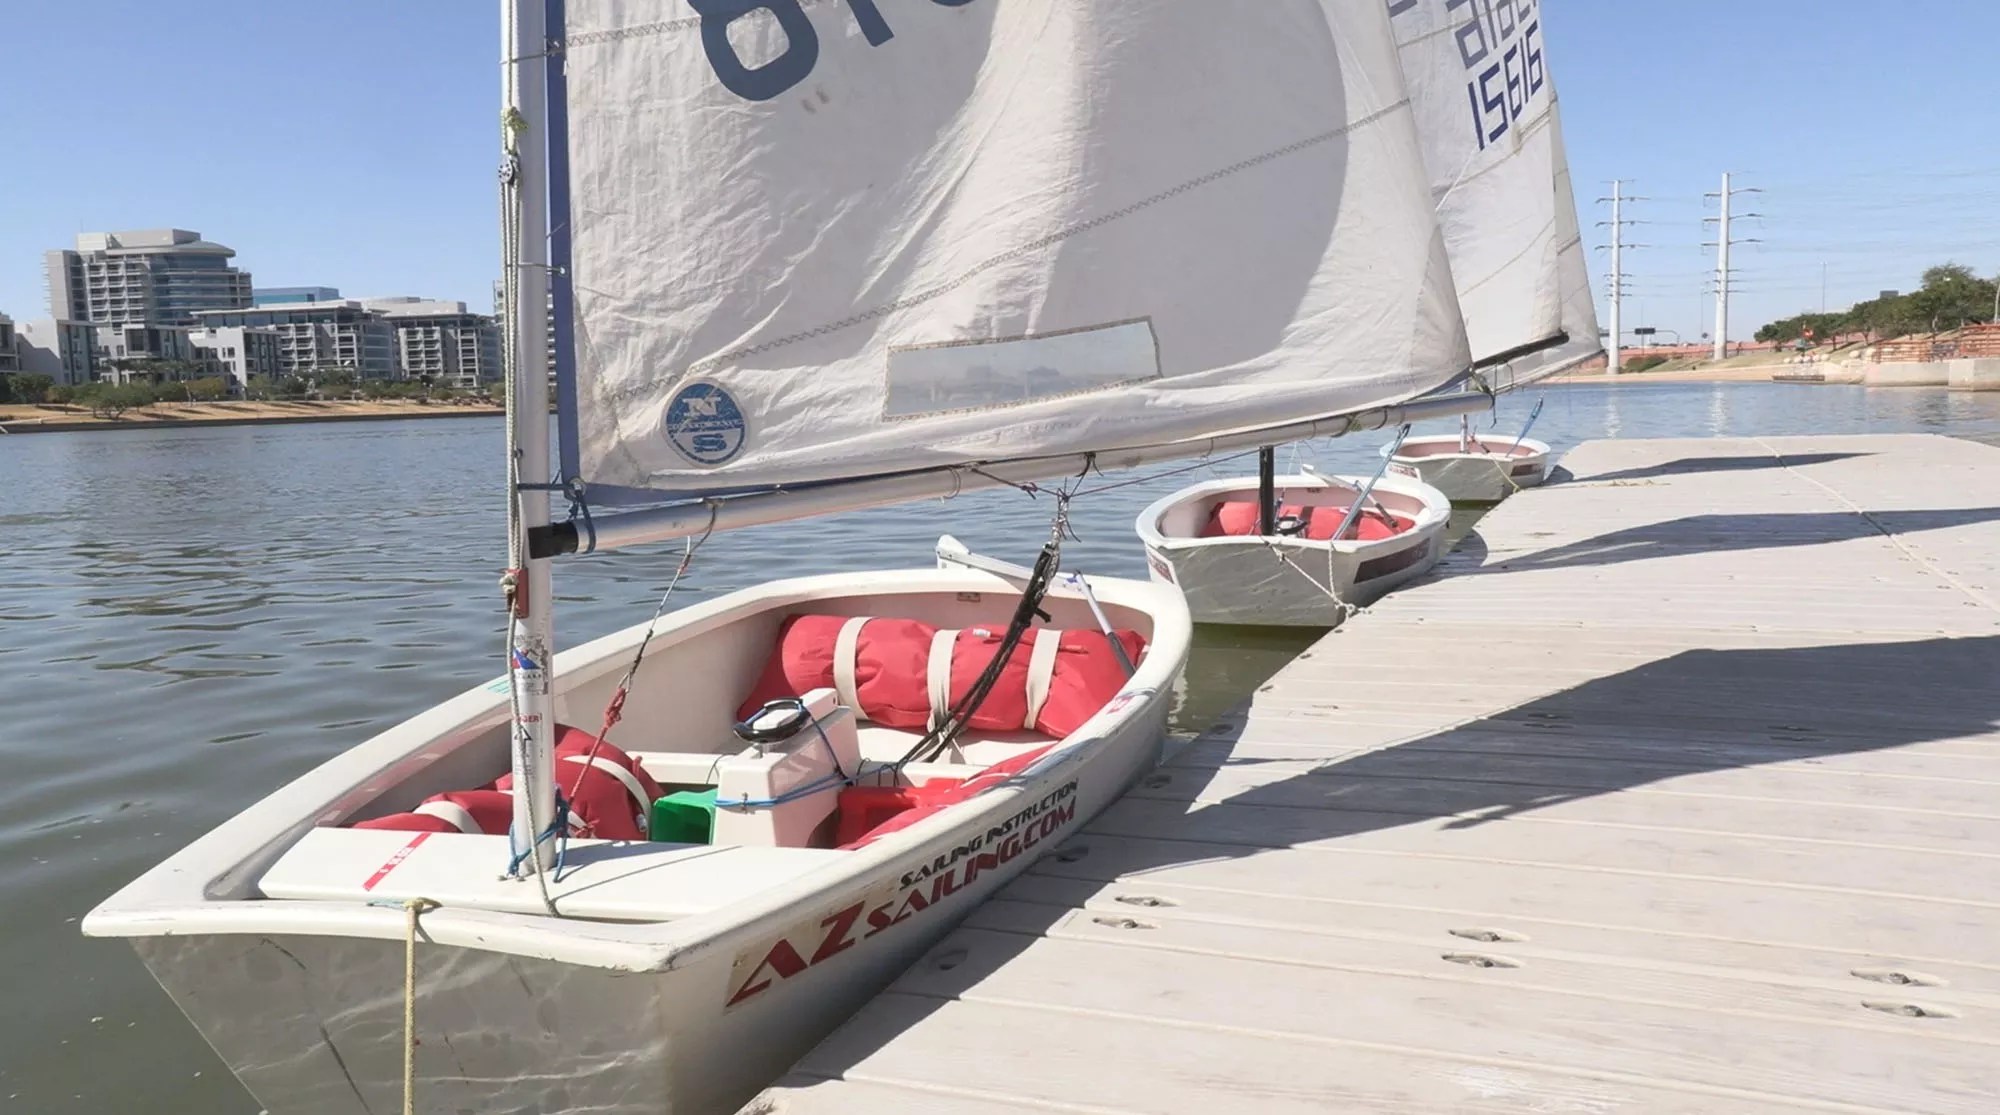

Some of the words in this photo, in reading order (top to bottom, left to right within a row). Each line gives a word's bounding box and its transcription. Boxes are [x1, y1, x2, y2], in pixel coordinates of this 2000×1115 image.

[1468, 20, 1543, 150] 15616
[899, 835, 982, 891] SAILING
[985, 778, 1079, 846] INSTRUCTION
